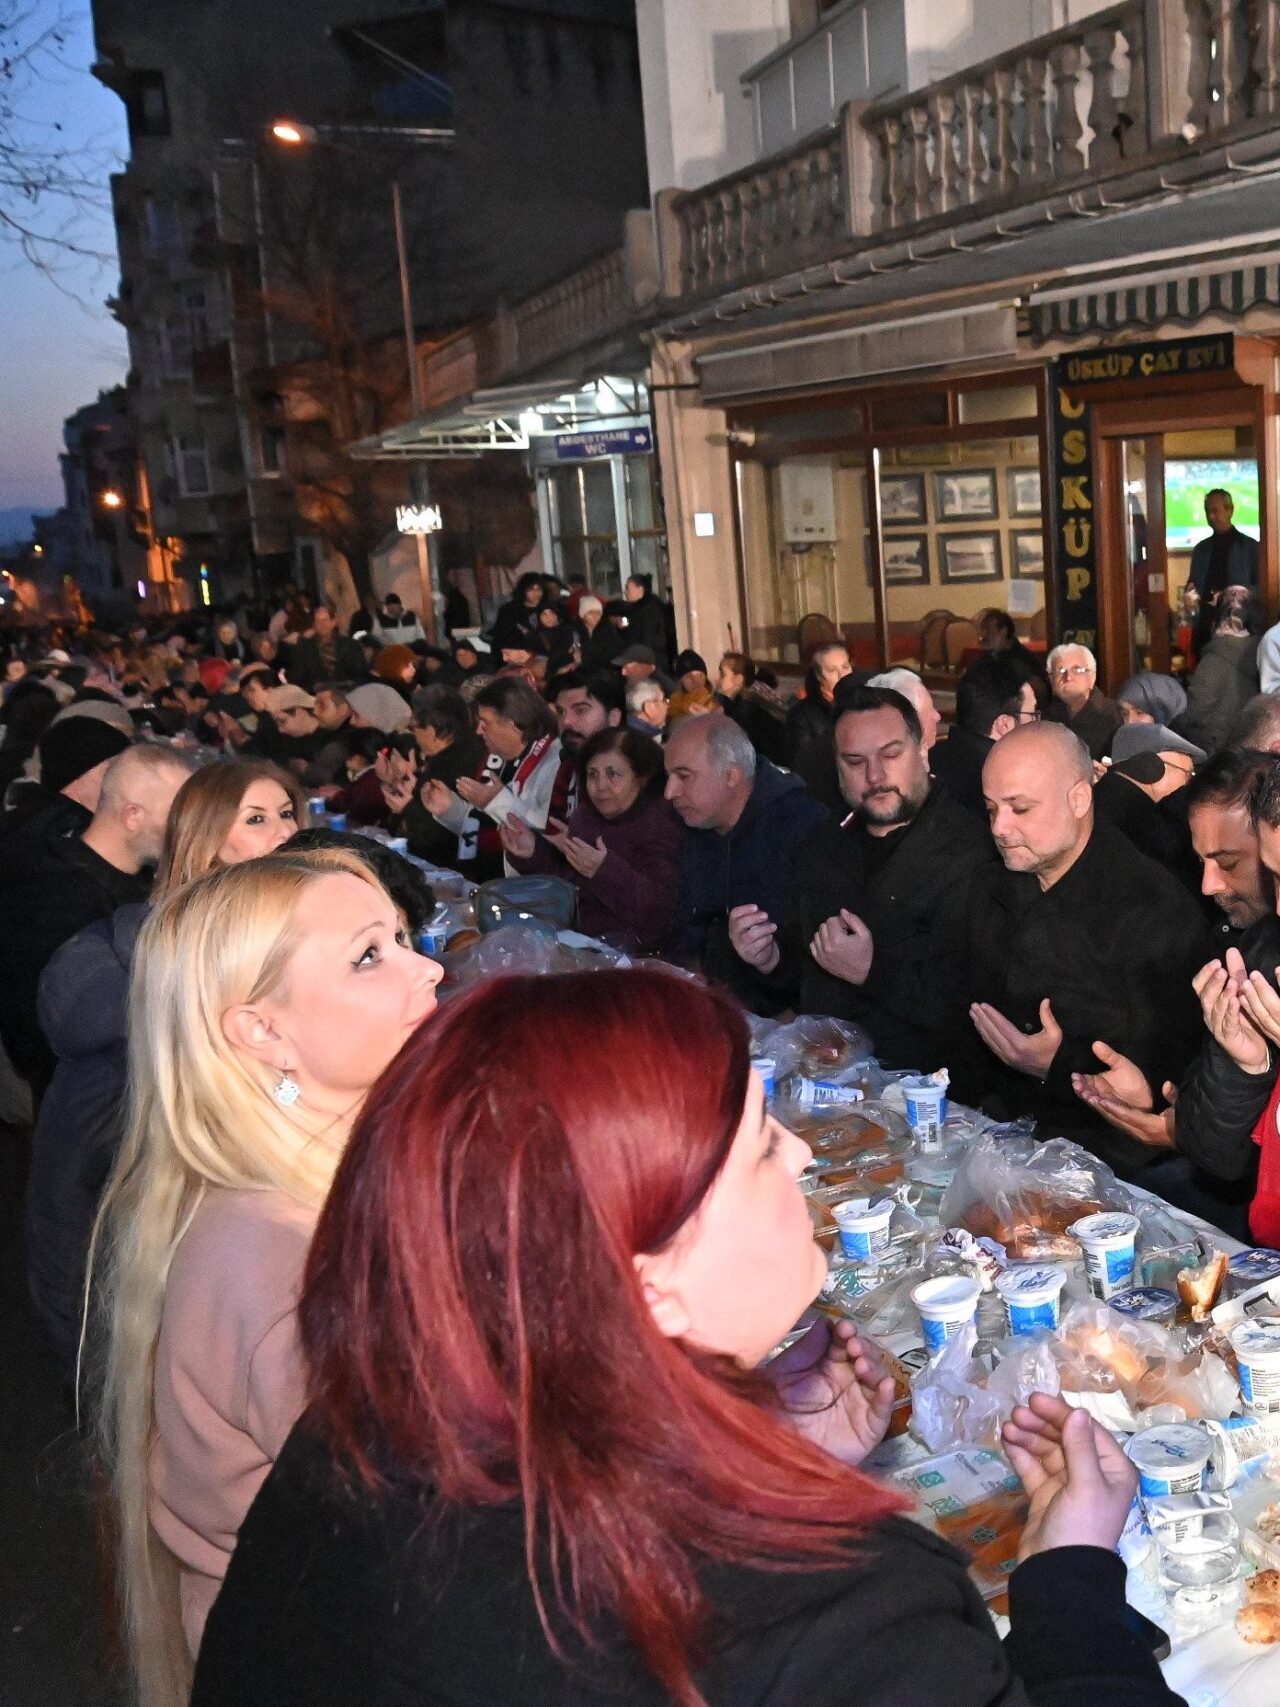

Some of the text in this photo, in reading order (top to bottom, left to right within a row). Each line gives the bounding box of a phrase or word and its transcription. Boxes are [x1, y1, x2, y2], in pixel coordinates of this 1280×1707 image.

[1066, 340, 1226, 382] ÜSKÜP ÇAY EVİ
[584, 444, 607, 454] WC
